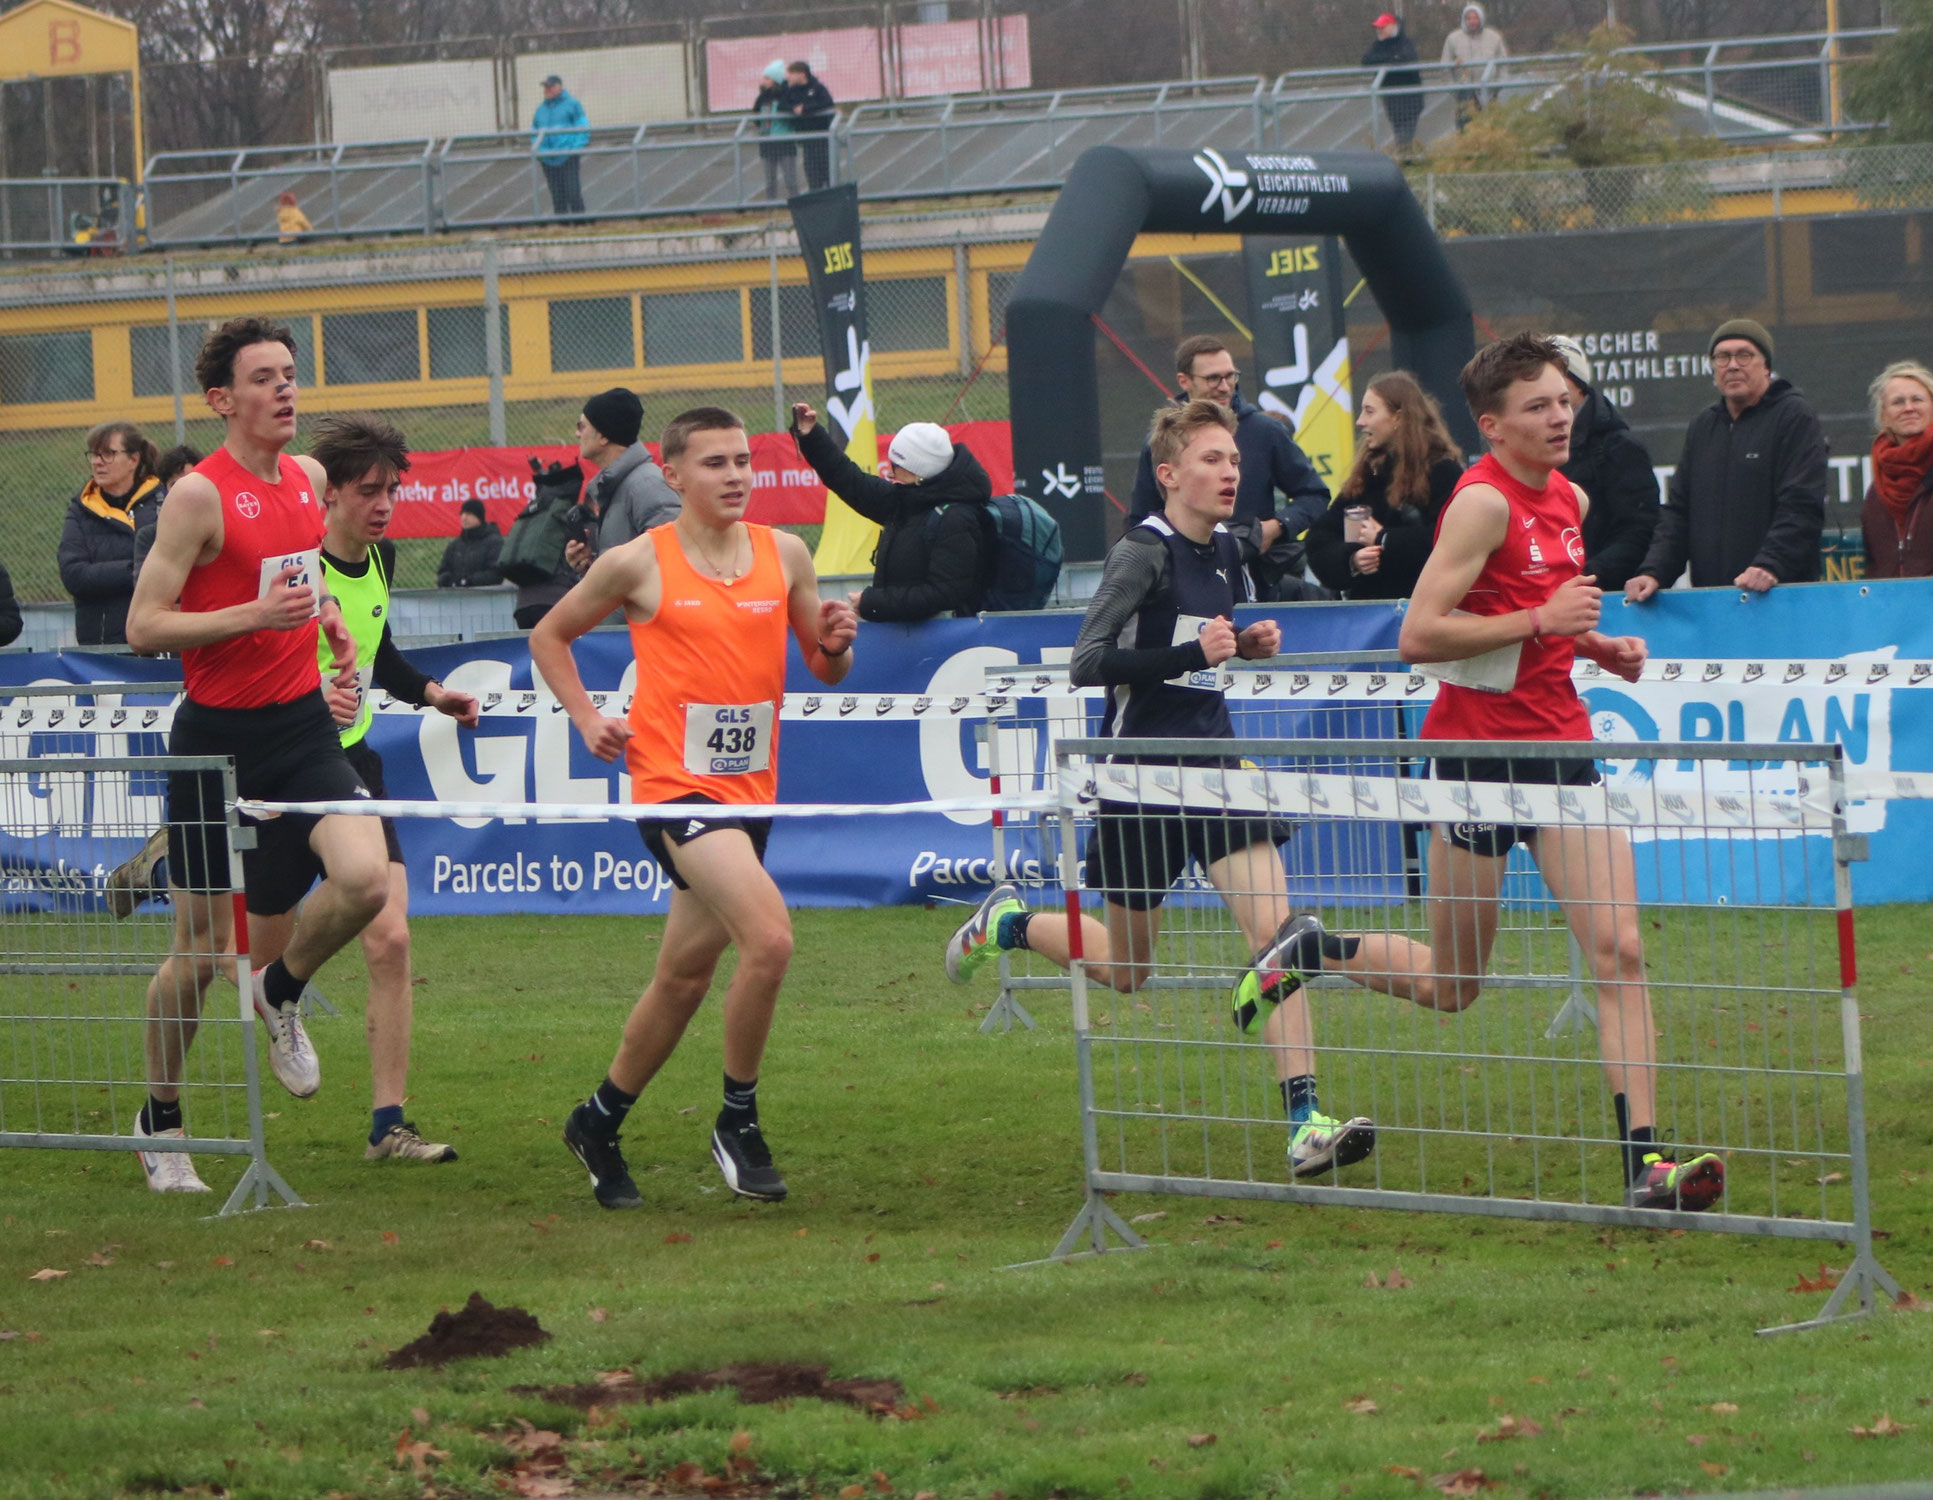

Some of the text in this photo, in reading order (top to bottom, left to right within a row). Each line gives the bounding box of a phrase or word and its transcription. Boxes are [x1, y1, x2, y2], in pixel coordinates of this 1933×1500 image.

[49, 19, 82, 66] B
[1246, 154, 1318, 171] DEUTSCHER
[1256, 173, 1349, 193] LEICHTATHLETIK
[1256, 197, 1310, 215] VERBAND
[441, 478, 471, 502] als
[474, 475, 521, 500] Geld
[1223, 674, 1235, 685] UN
[1256, 674, 1272, 686] RUN
[1293, 674, 1310, 686] RUN
[1331, 674, 1348, 686] RUN
[1370, 674, 1387, 686] RUN
[1409, 674, 1426, 686] RUN
[1665, 663, 1683, 675] RUN
[1706, 663, 1724, 675] RUN
[1746, 663, 1764, 676] RUN
[1787, 663, 1806, 676] RUN
[1828, 663, 1848, 676] RUN
[1871, 663, 1890, 676] RUN
[1913, 663, 1932, 676] RUN
[805, 696, 823, 708] RUN
[841, 696, 860, 708] RUN
[878, 697, 896, 708] RUN
[715, 708, 751, 723] GLS
[706, 726, 757, 754] 438
[1676, 692, 1871, 772] PLAN
[419, 659, 639, 829] GL
[728, 757, 749, 767] PLAN
[433, 851, 541, 894] Parcels
[550, 854, 584, 892] to
